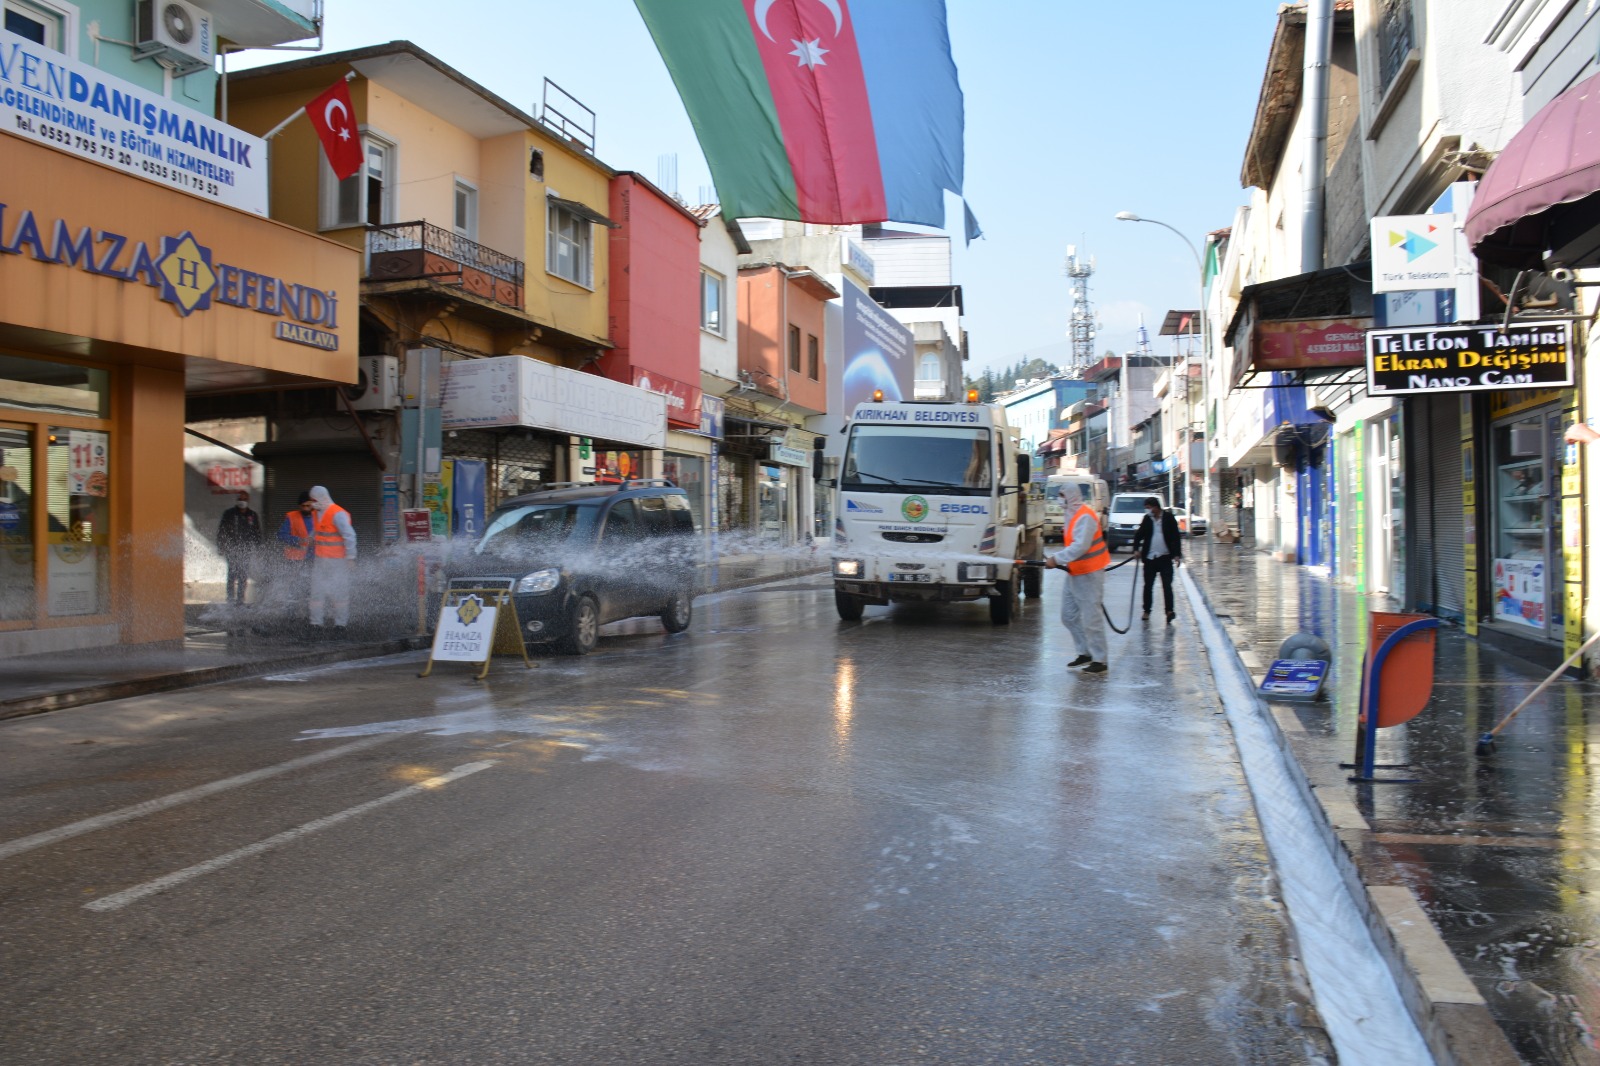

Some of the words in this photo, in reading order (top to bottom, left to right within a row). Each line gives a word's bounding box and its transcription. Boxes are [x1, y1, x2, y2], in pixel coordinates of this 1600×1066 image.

[200, 17, 209, 54] REGAL
[0, 86, 96, 137] GELENDİRME
[100, 127, 116, 143] ve
[121, 129, 162, 161] EĞİTİM
[167, 147, 235, 187] HİZMETELERİ
[16, 115, 36, 133] Tel.
[40, 124, 71, 146] 0552
[75, 136, 97, 154] 795
[101, 145, 115, 160] 75
[118, 151, 132, 166] 20
[142, 160, 168, 179] 0535
[171, 170, 188, 185] 511
[193, 177, 204, 191] 75
[207, 184, 218, 196] 52
[1382, 272, 1405, 281] Türk
[1407, 271, 1450, 281] Telekom
[177, 257, 200, 289] H
[215, 263, 338, 329] EFENDİ
[282, 323, 338, 350] BAKLAVA
[855, 409, 908, 421] KIRIKHAN
[914, 410, 980, 423] BELEDİYESİ
[940, 503, 988, 515] 2520L
[443, 640, 481, 652] EFENDİ
[444, 631, 482, 641] HAMZA
